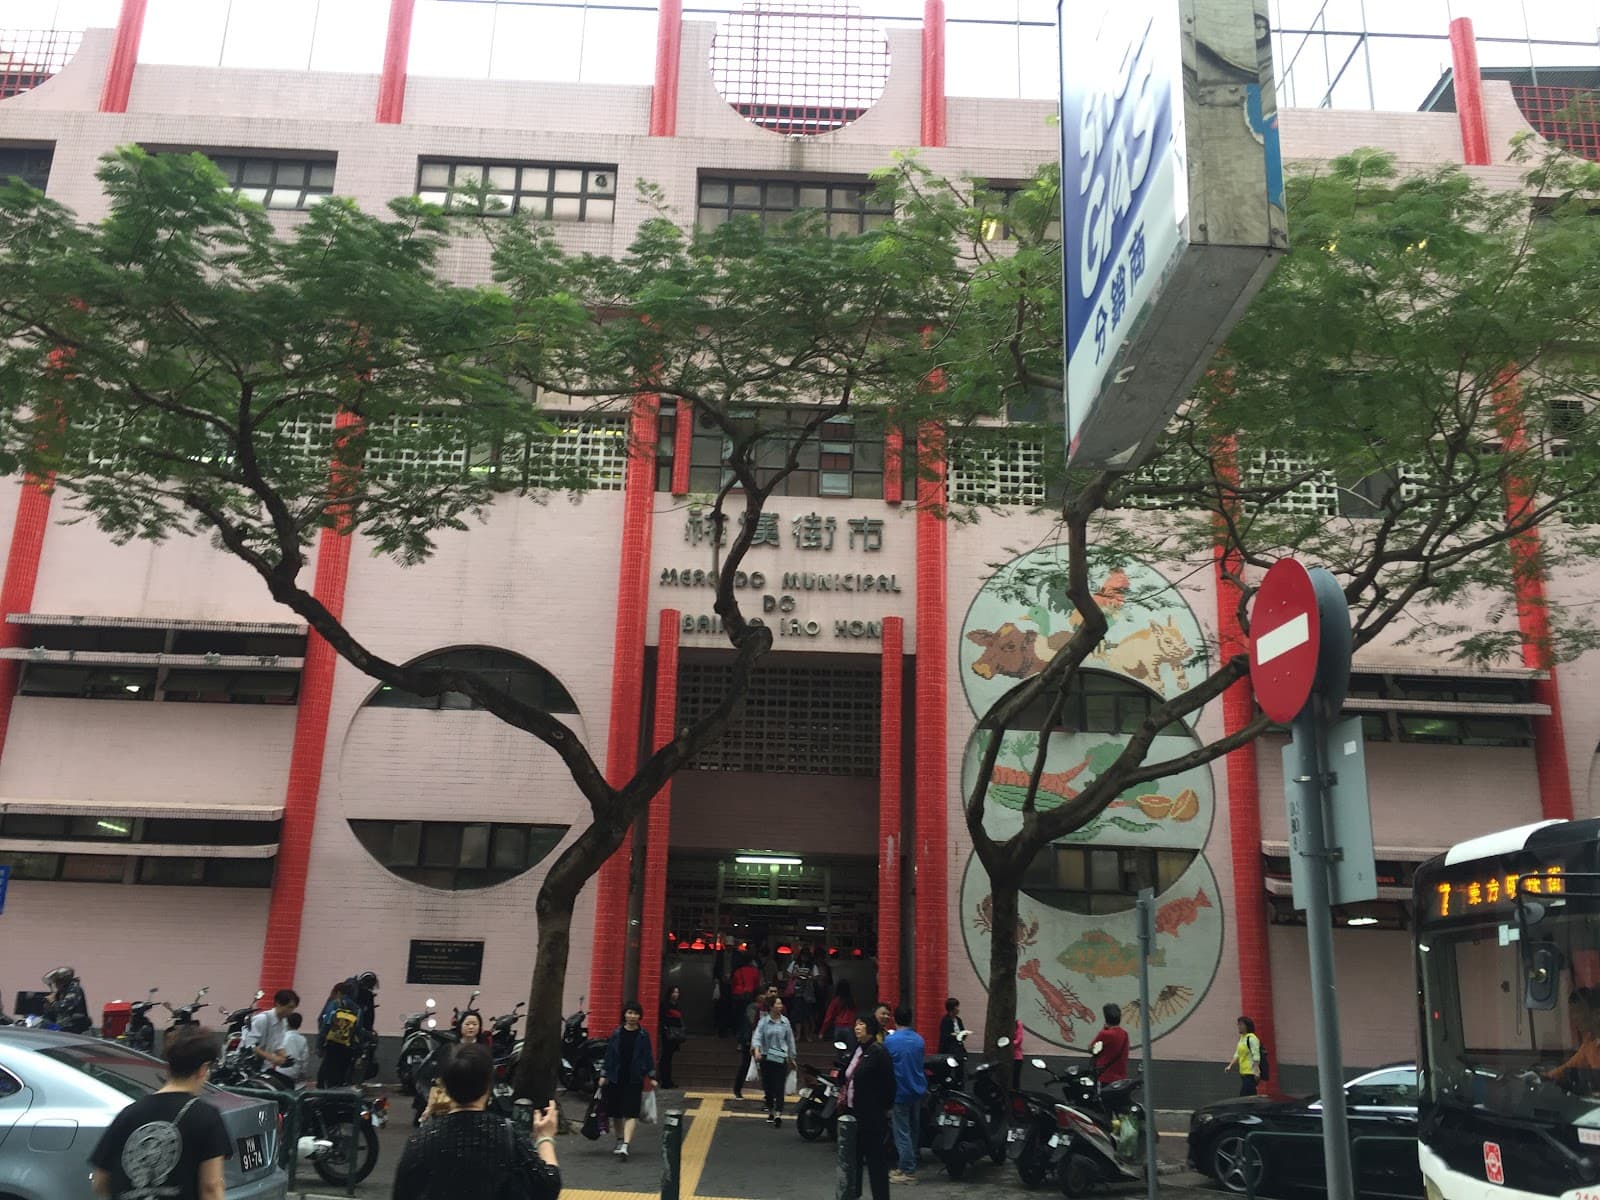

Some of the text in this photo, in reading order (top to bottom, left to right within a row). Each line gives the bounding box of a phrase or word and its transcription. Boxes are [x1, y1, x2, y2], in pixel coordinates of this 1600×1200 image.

[1094, 220, 1146, 367] 分銷商
[660, 567, 901, 592] MERCDO MUNICIPAL
[763, 594, 796, 613] DO
[1438, 882, 1451, 916] 7
[243, 1151, 263, 1170] 91-74
